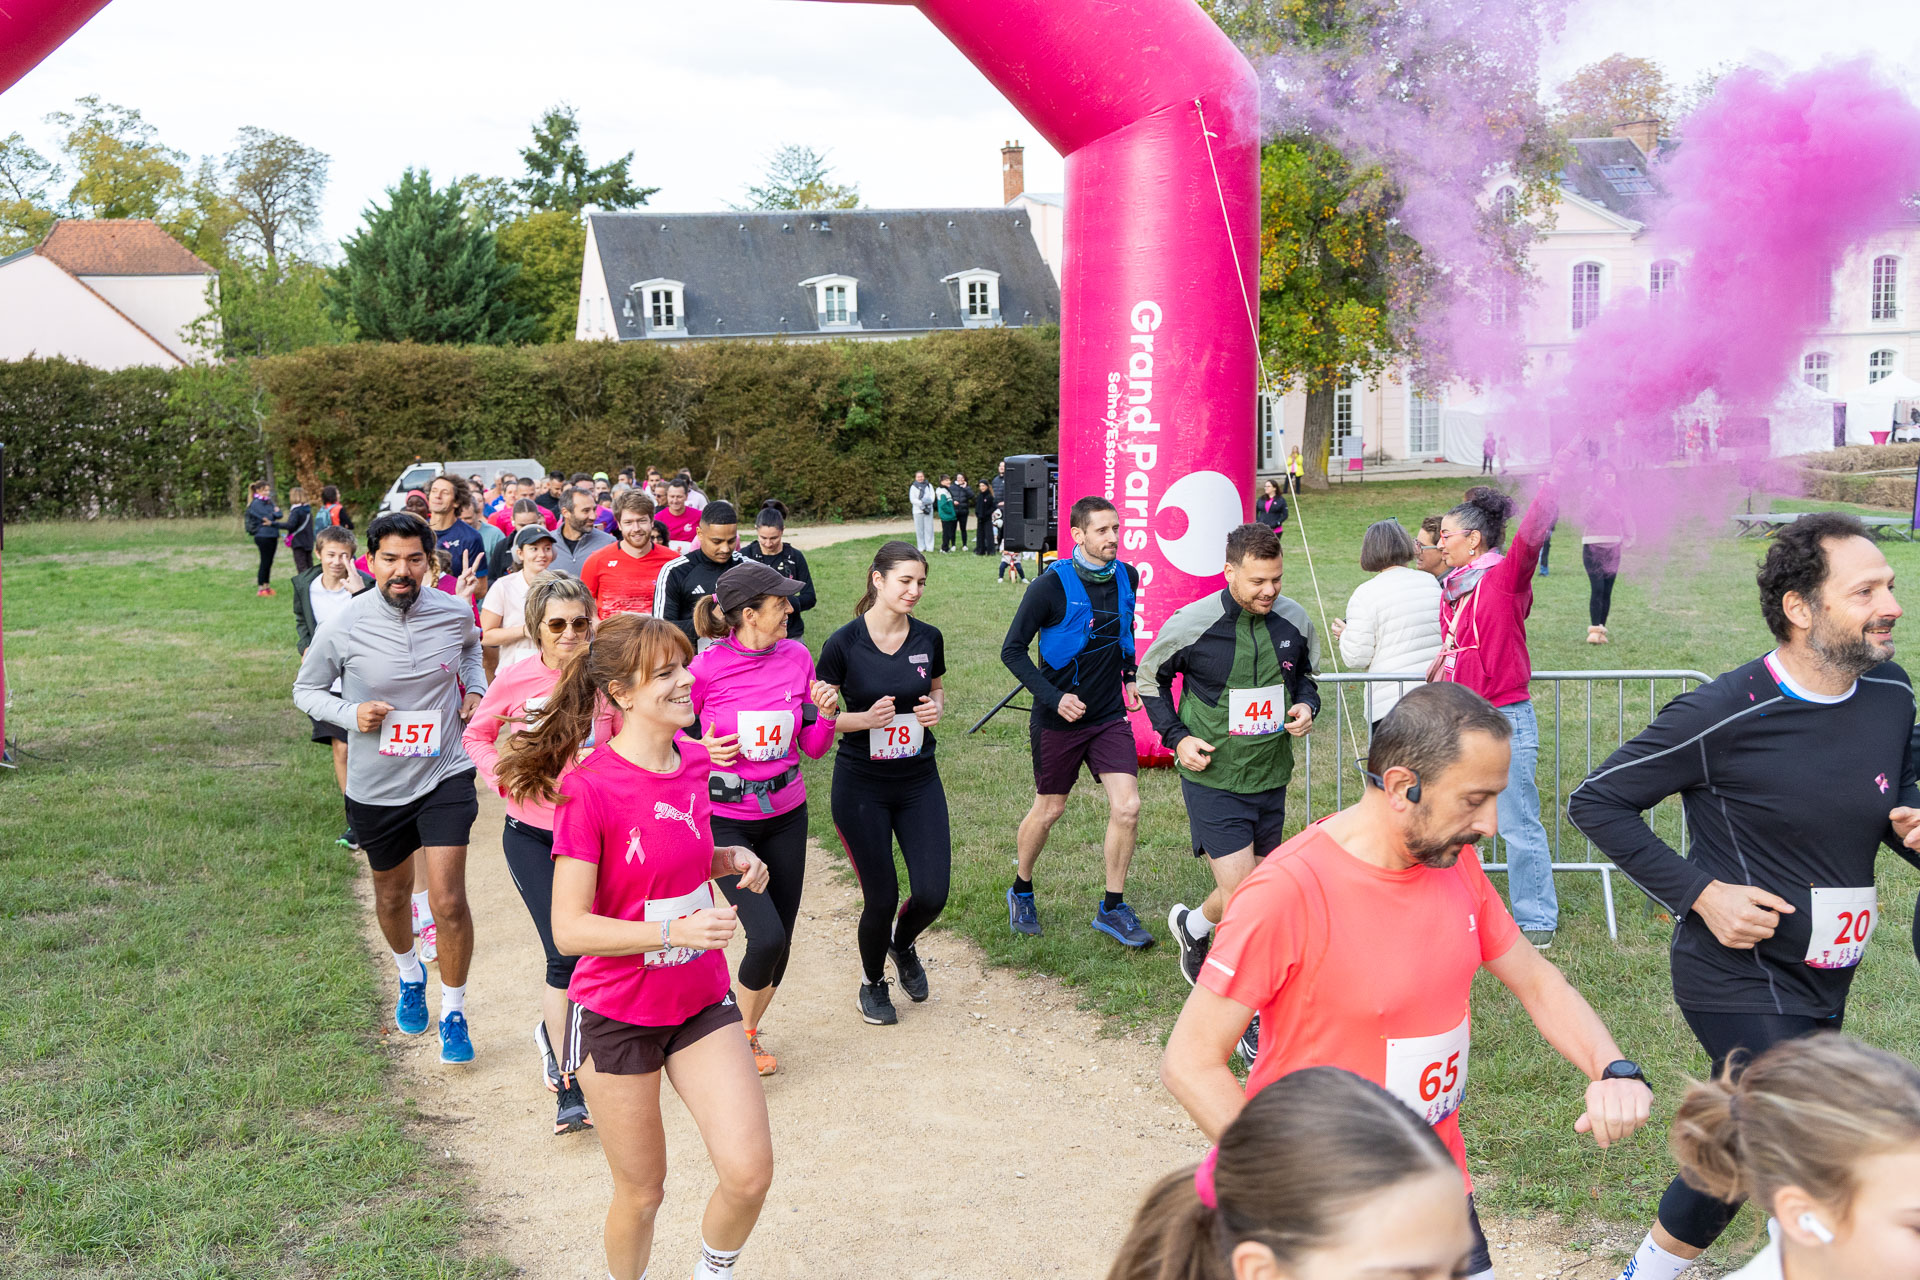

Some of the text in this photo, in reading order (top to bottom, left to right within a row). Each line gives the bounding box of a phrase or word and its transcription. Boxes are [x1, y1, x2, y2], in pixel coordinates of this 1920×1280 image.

[1128, 300, 1162, 432] Grand
[1123, 444, 1158, 550] Paris
[1244, 700, 1273, 721] 44
[390, 723, 434, 743] 157
[755, 725, 782, 746] 14
[884, 726, 911, 746] 78
[1833, 909, 1870, 945] 20
[1418, 1050, 1460, 1102] 65
